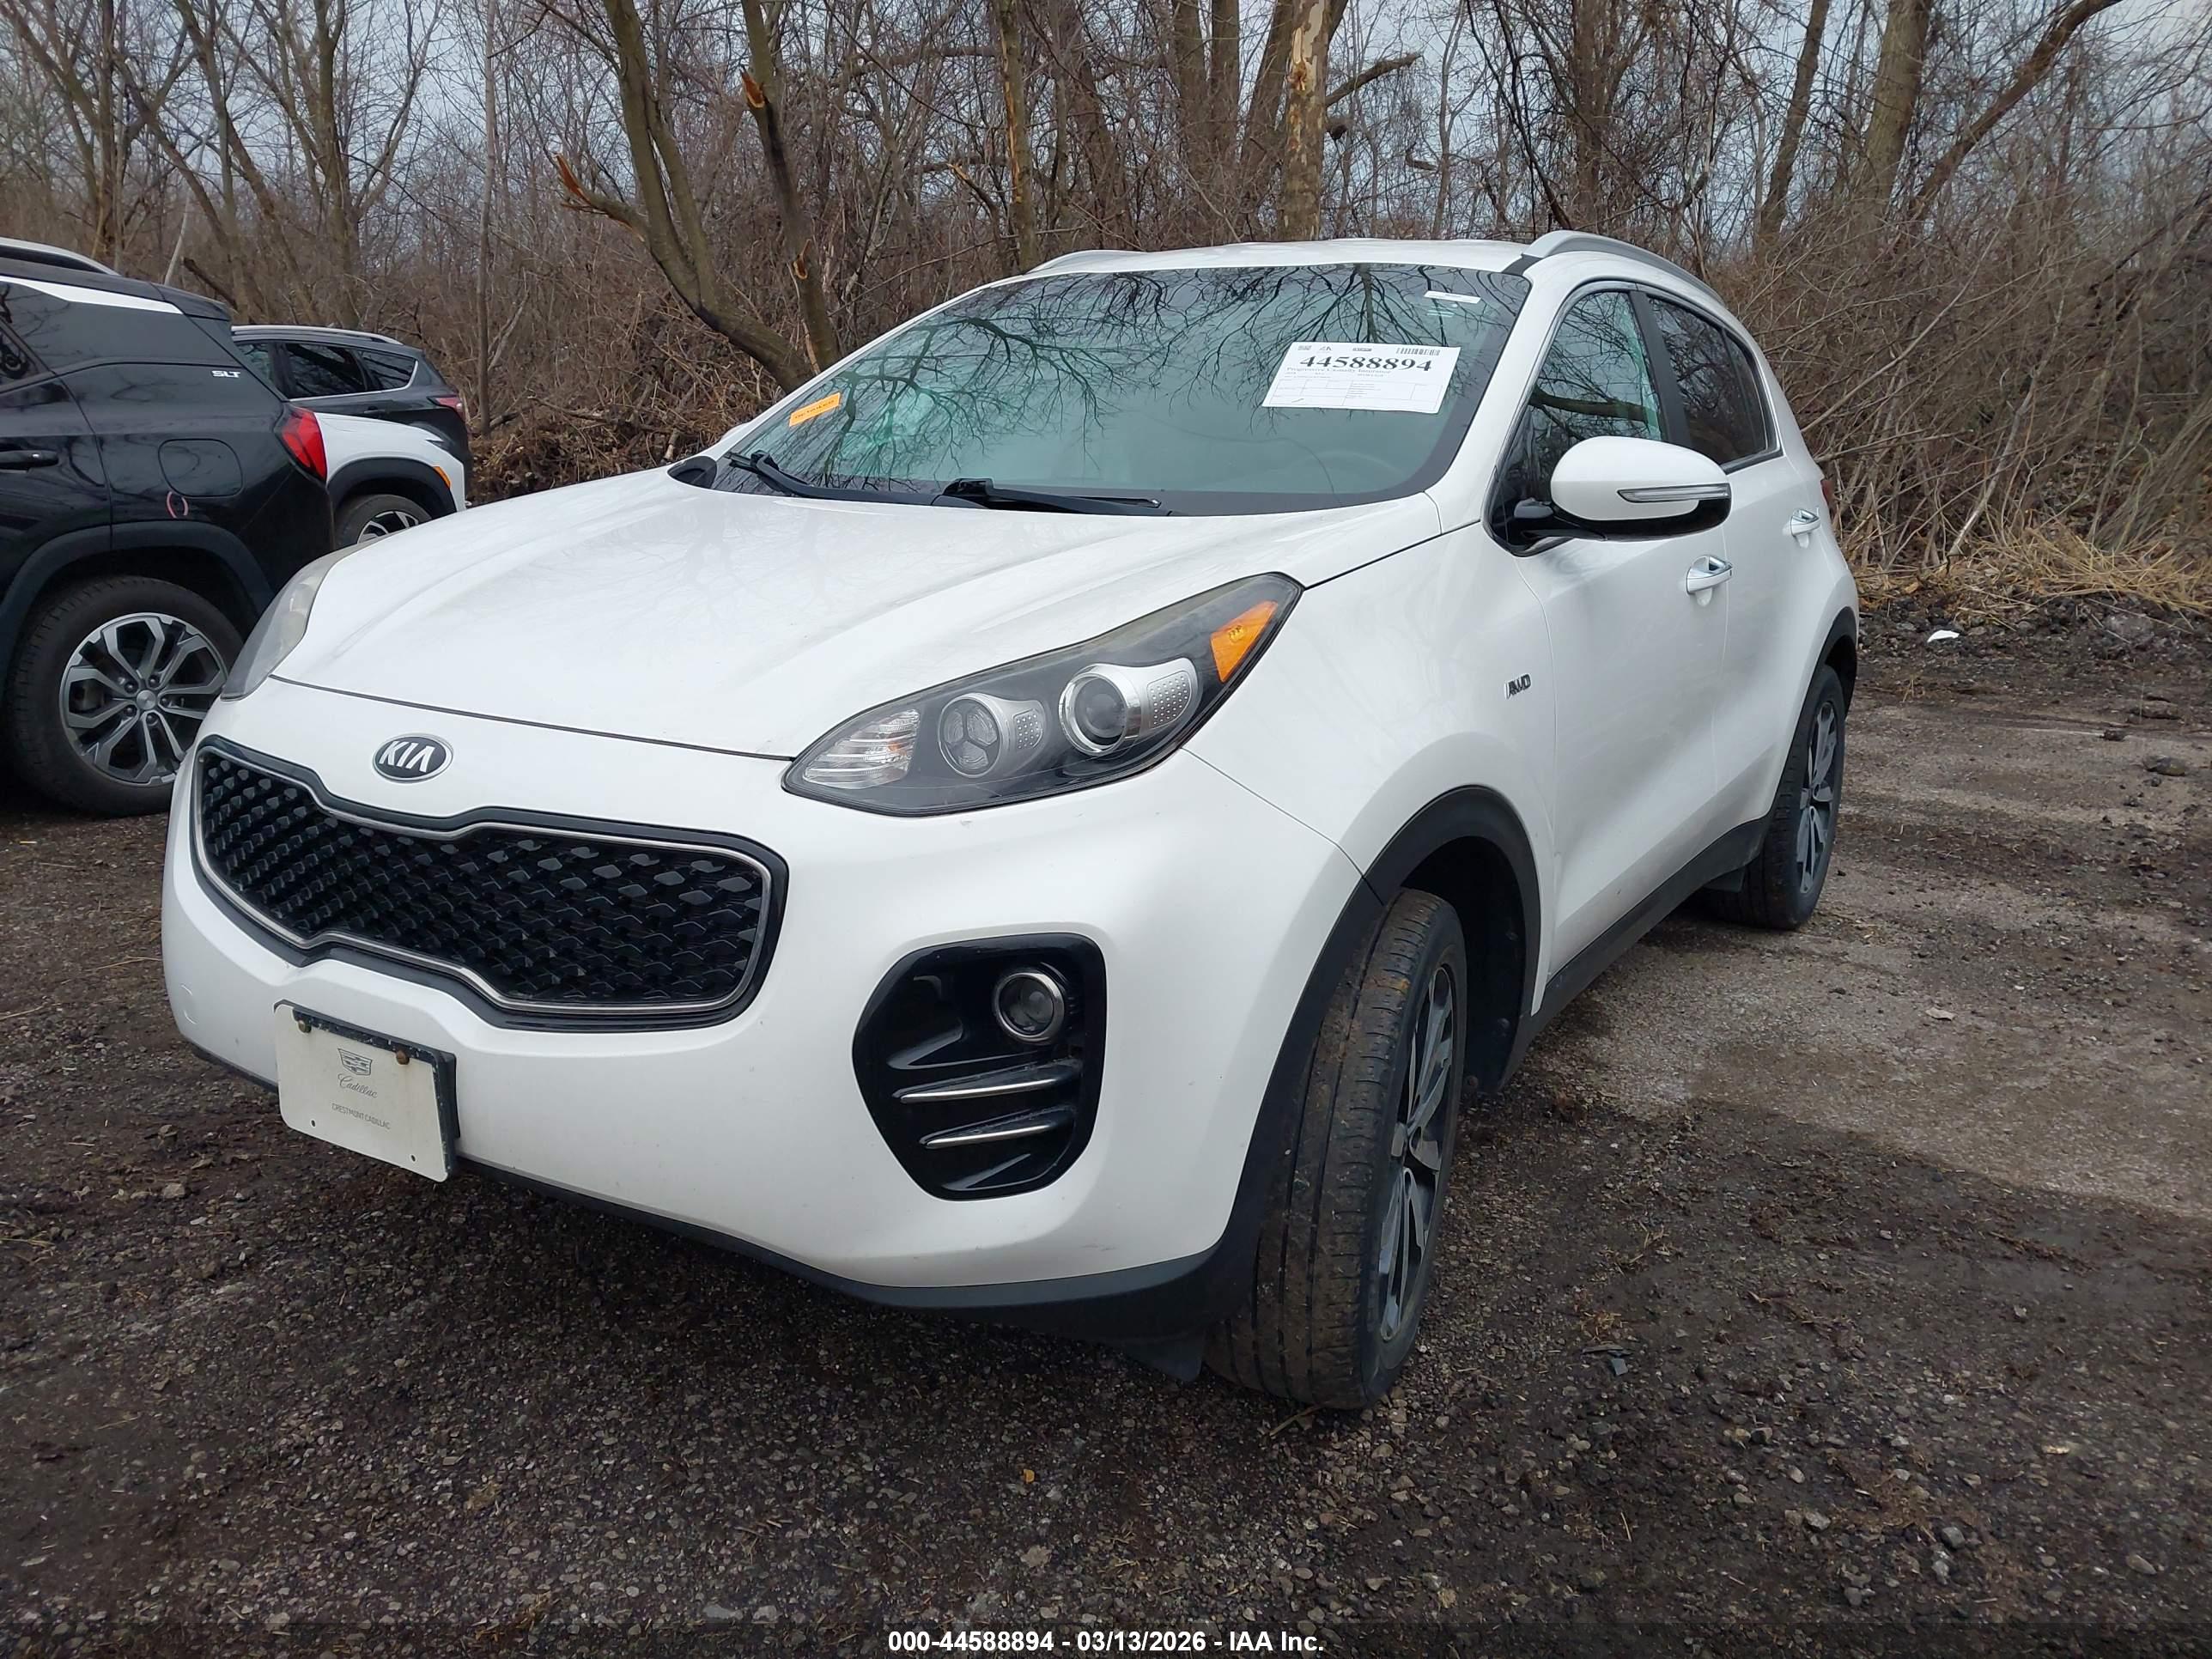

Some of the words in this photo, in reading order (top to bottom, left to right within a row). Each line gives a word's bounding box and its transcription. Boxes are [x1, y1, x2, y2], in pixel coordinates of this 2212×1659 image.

[211, 370, 241, 379] SLT
[1299, 356, 1432, 372] 44588894
[378, 740, 436, 773] KIA
[337, 1073, 378, 1098] Cadillac
[331, 1103, 364, 1120] CRESTMONT
[364, 1113, 392, 1130] CADILLAC
